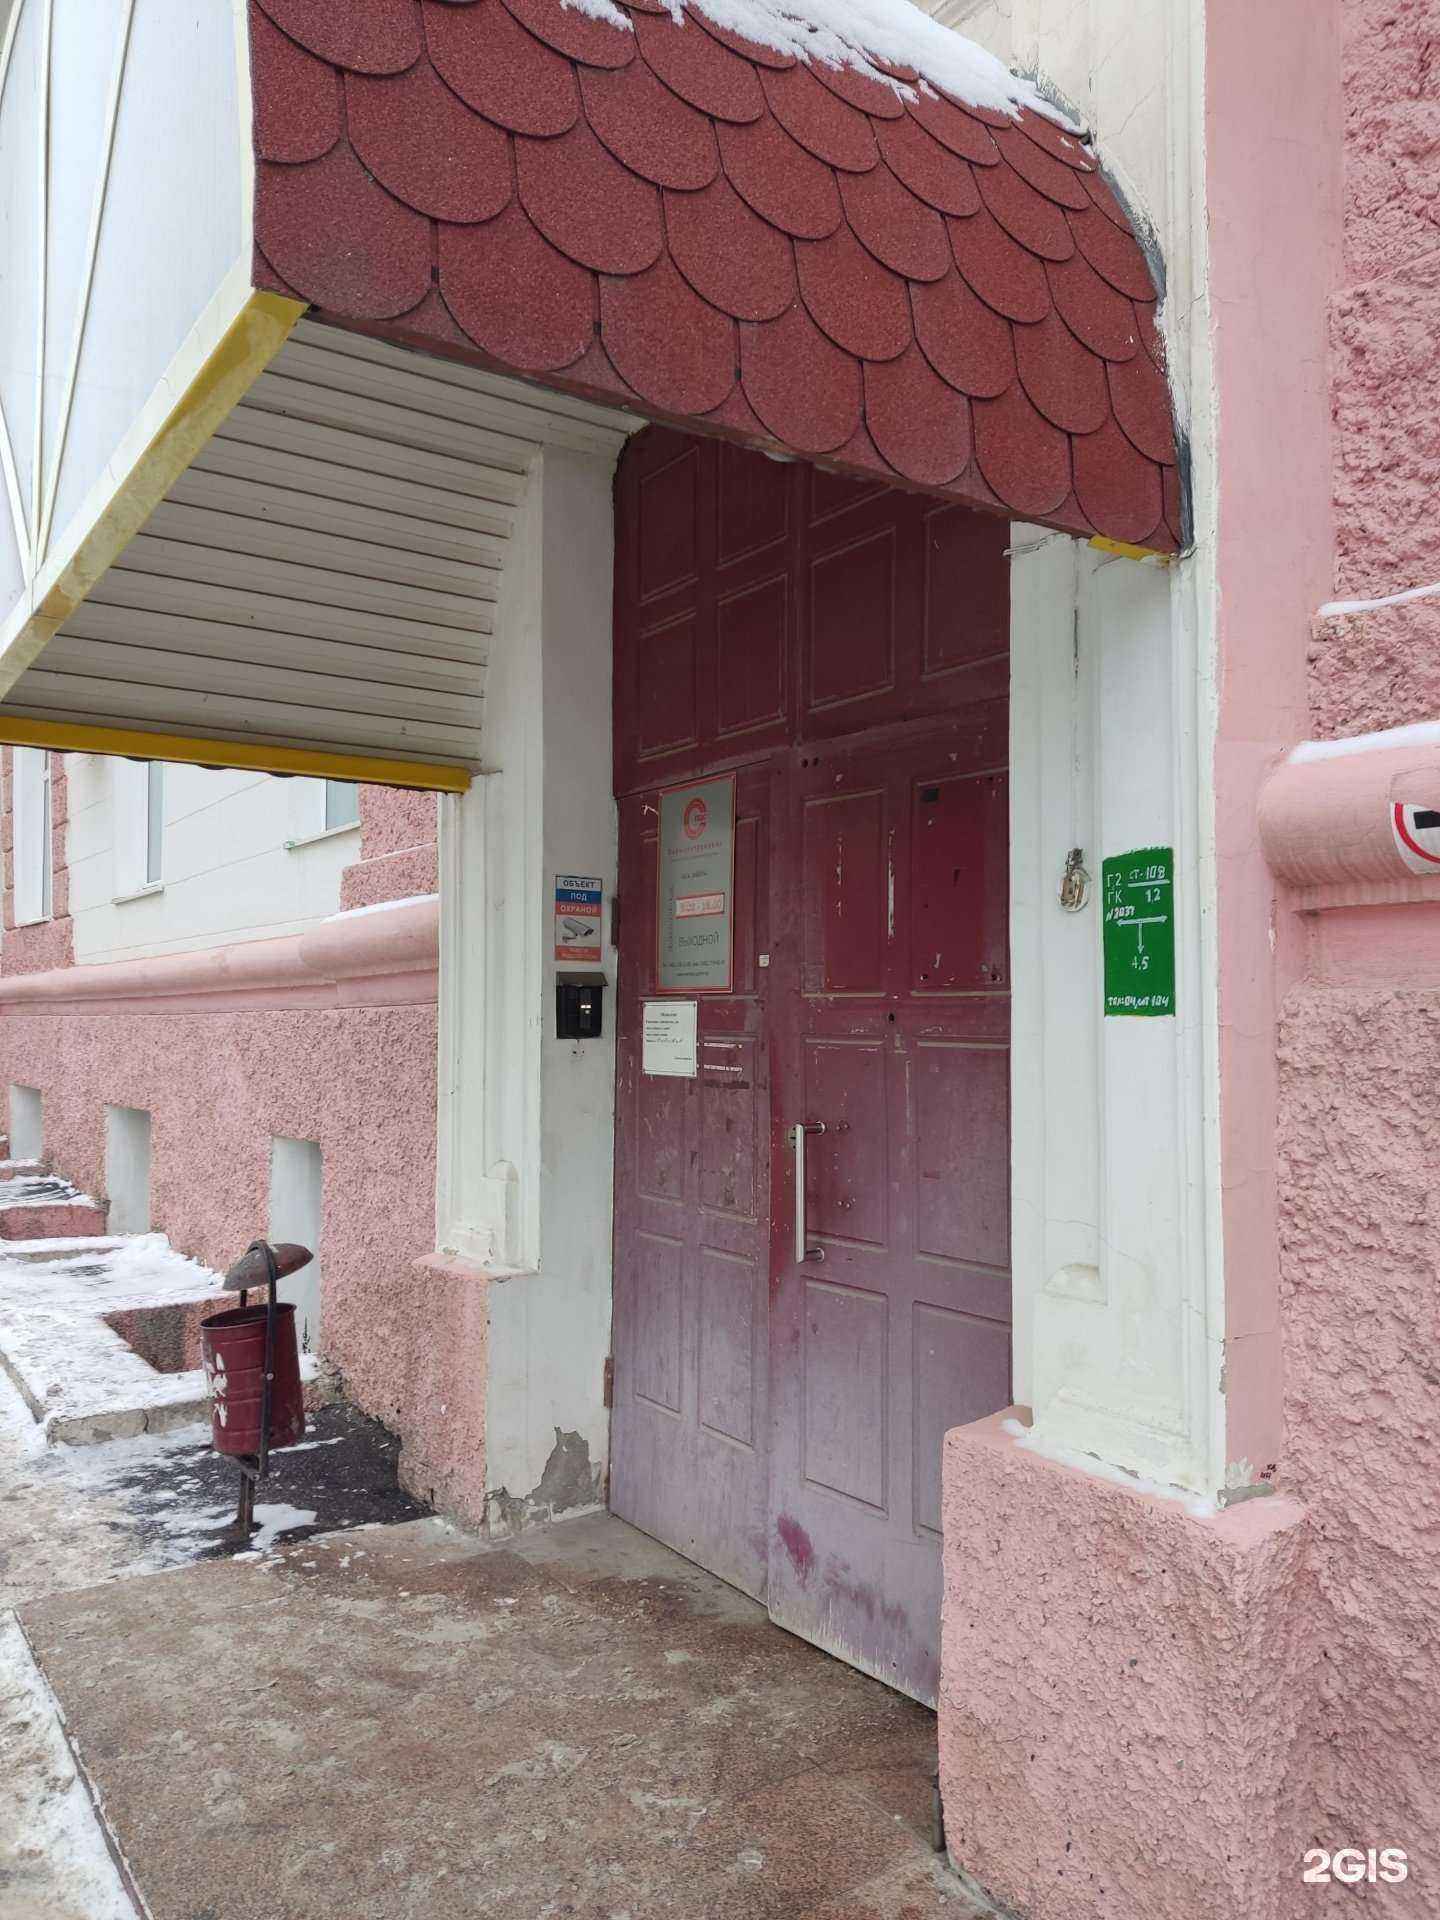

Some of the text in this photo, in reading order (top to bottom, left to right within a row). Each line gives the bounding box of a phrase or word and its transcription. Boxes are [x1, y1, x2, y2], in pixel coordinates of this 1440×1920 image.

[562, 879, 597, 888] ОБЪЕКТ
[570, 892, 587, 901] ПОД
[560, 903, 598, 914] ОХРАНОЙ
[679, 930, 720, 947] ВЫХОДНОЙ
